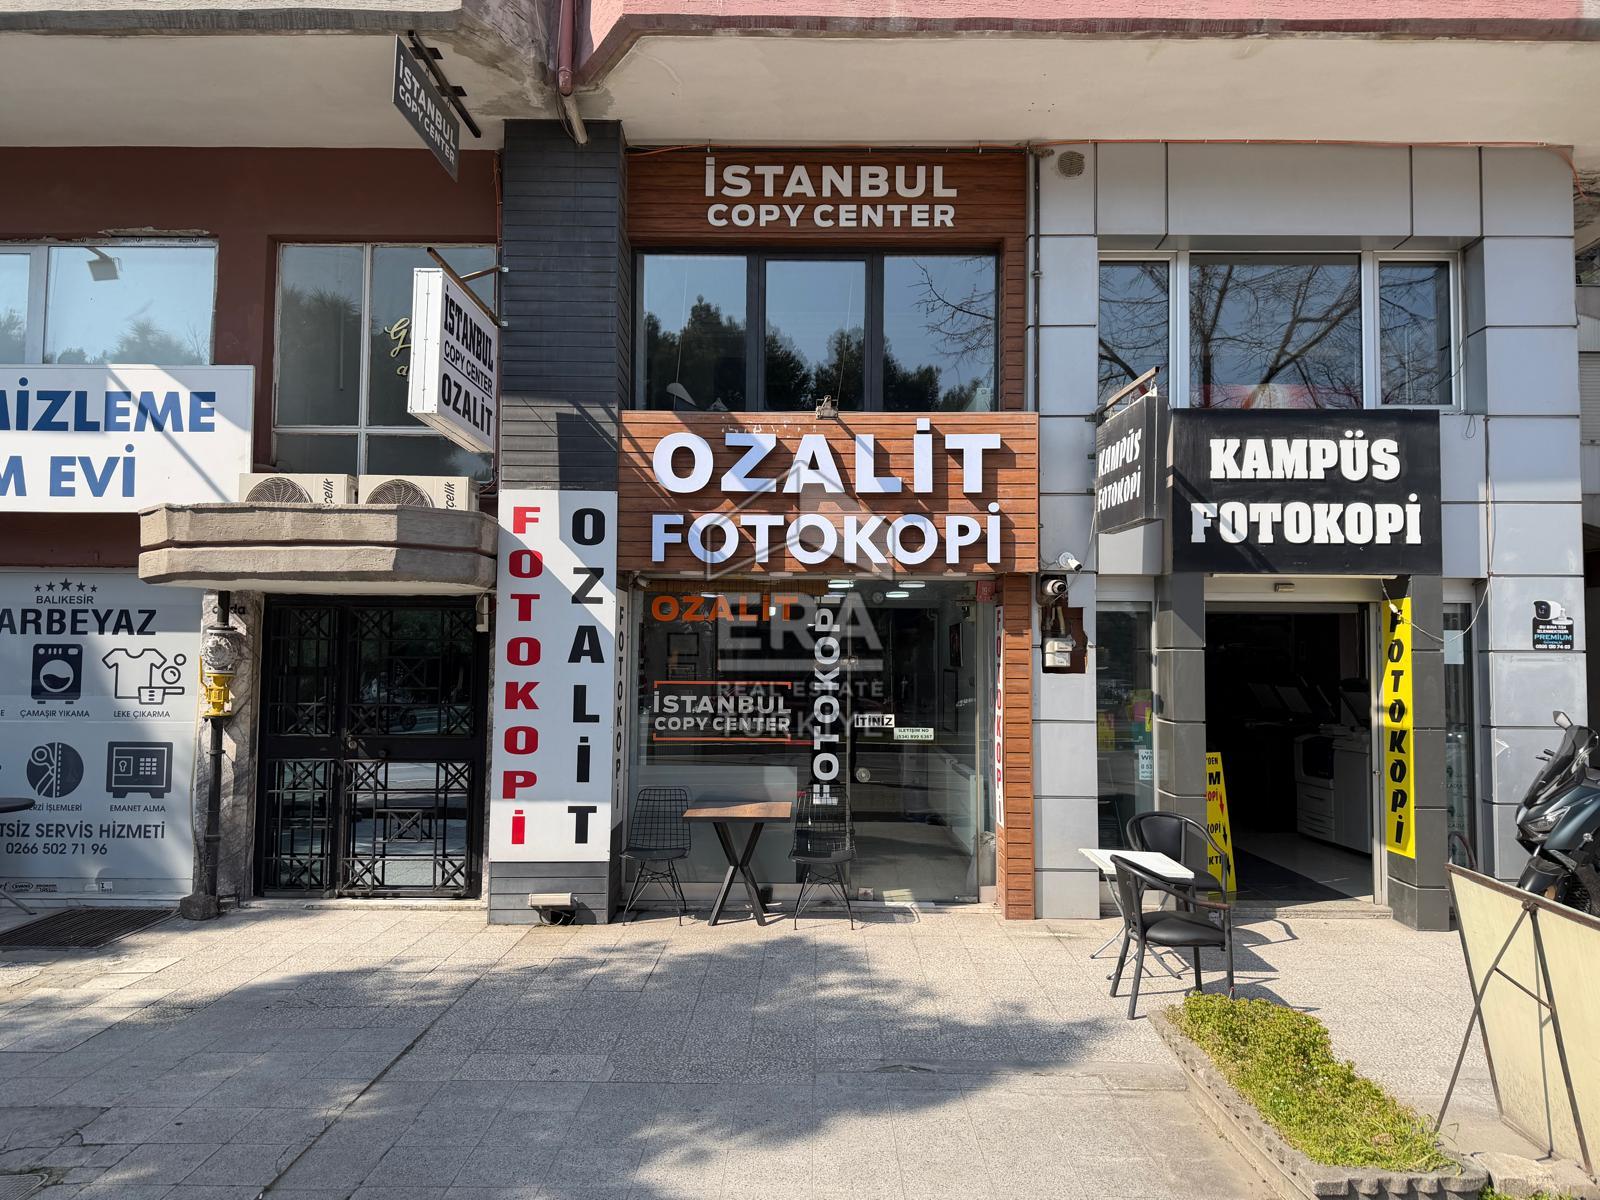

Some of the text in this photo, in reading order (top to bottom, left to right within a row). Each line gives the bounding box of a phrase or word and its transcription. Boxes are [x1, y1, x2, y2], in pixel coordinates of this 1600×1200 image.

[398, 84, 455, 165] COPY CENTER
[399, 54, 456, 150] İSTANBUL
[704, 157, 958, 198] İSTANBUL
[707, 204, 956, 228] COPY CENTER
[443, 284, 494, 373] İSTANBUL
[444, 339, 493, 396] COPY CENTER
[441, 373, 493, 437] OZALİT
[50, 444, 136, 498] EVİ
[652, 418, 1001, 494] OZALİT
[1097, 428, 1142, 478] KAMPÜS
[1210, 429, 1400, 482] KAMPÜS
[1097, 465, 1142, 513] FOTOKOPİ
[651, 501, 1001, 564] FOTOKOPİ
[1190, 493, 1422, 546] FOTOKOPİ
[36, 594, 94, 605] BALIKESİR
[502, 506, 544, 845] FOTOKOPİ
[567, 507, 606, 845] OZALİT
[20, 709, 90, 719] ÇAMAŞIR YIKAMA
[113, 710, 171, 719] LEKE ÇIKARMA
[615, 606, 626, 811] FOTOKOPİ
[652, 691, 792, 714] İSTANBUL
[654, 716, 790, 731] COPY CENTER
[1387, 609, 1408, 845] FOTOKOPİ
[35, 821, 93, 839] SERVİS
[99, 821, 166, 839] HİZMETİ
[110, 804, 166, 813] EMANET ALMA
[6, 842, 108, 855] 0266 502 71 96
